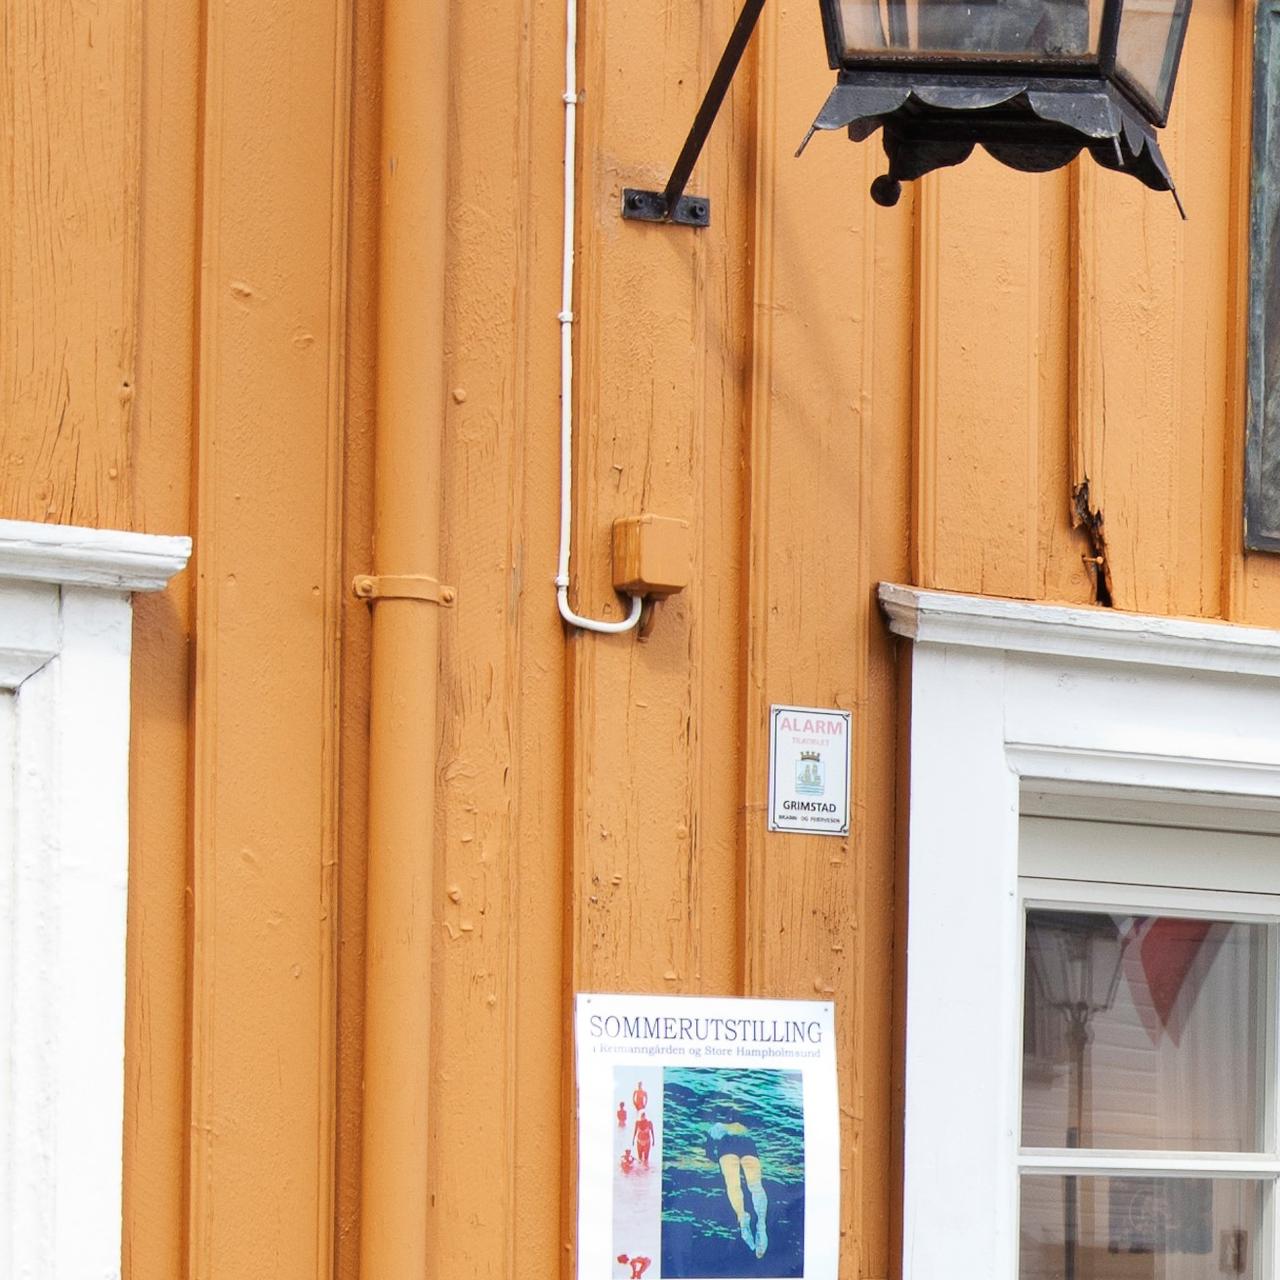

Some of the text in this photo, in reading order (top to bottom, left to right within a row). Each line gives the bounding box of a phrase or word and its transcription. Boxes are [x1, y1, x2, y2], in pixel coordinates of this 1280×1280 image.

[780, 717, 843, 735] ALARM
[783, 800, 837, 813] GRIMSTAD
[590, 1015, 822, 1044] SOMMERUTSTILLING
[600, 1044, 685, 1057] Reimanngården
[688, 1047, 702, 1058] og
[704, 1045, 732, 1057] Store
[736, 1046, 821, 1060] Hampholmsund
